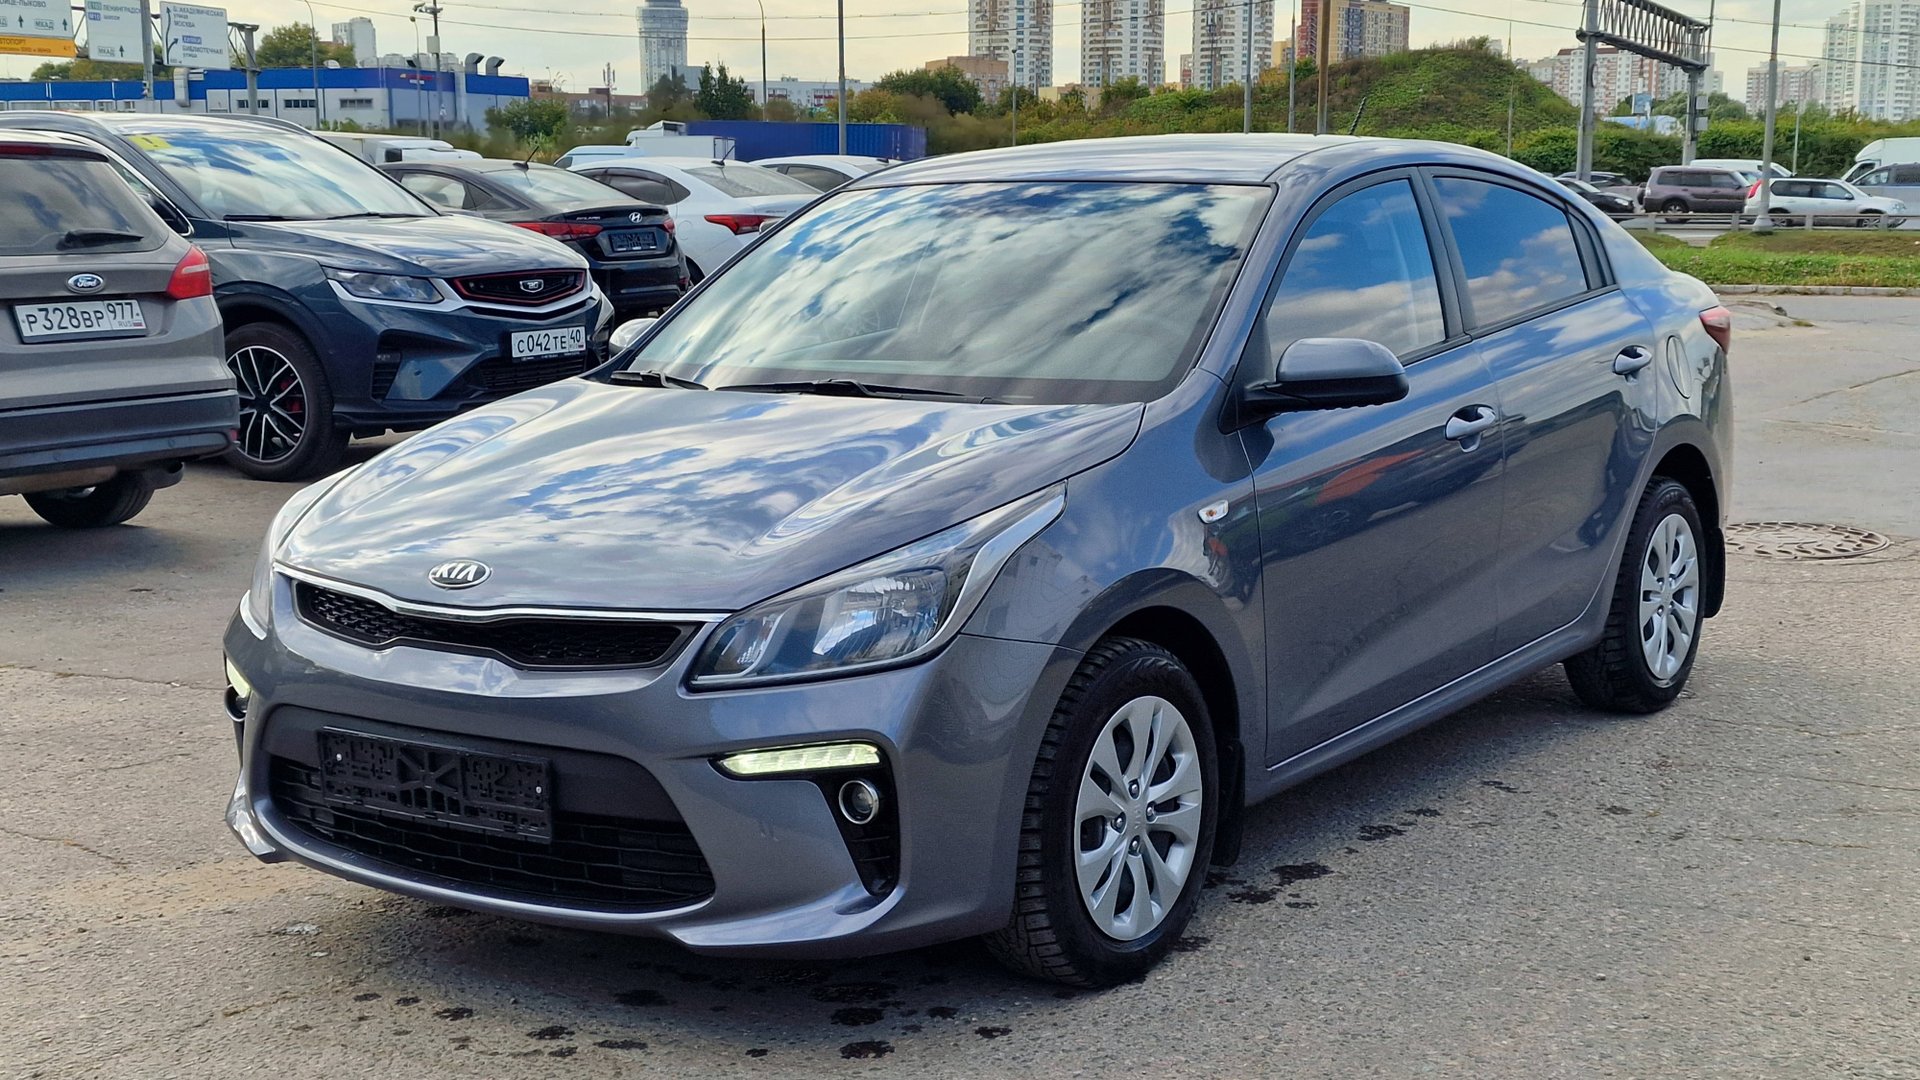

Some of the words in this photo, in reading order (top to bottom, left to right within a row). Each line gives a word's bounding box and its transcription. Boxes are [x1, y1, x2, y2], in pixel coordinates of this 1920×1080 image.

[76, 276, 98, 288] Ford
[106, 302, 135, 321] 977
[570, 329, 581, 344] 40
[436, 562, 478, 582] KIA
